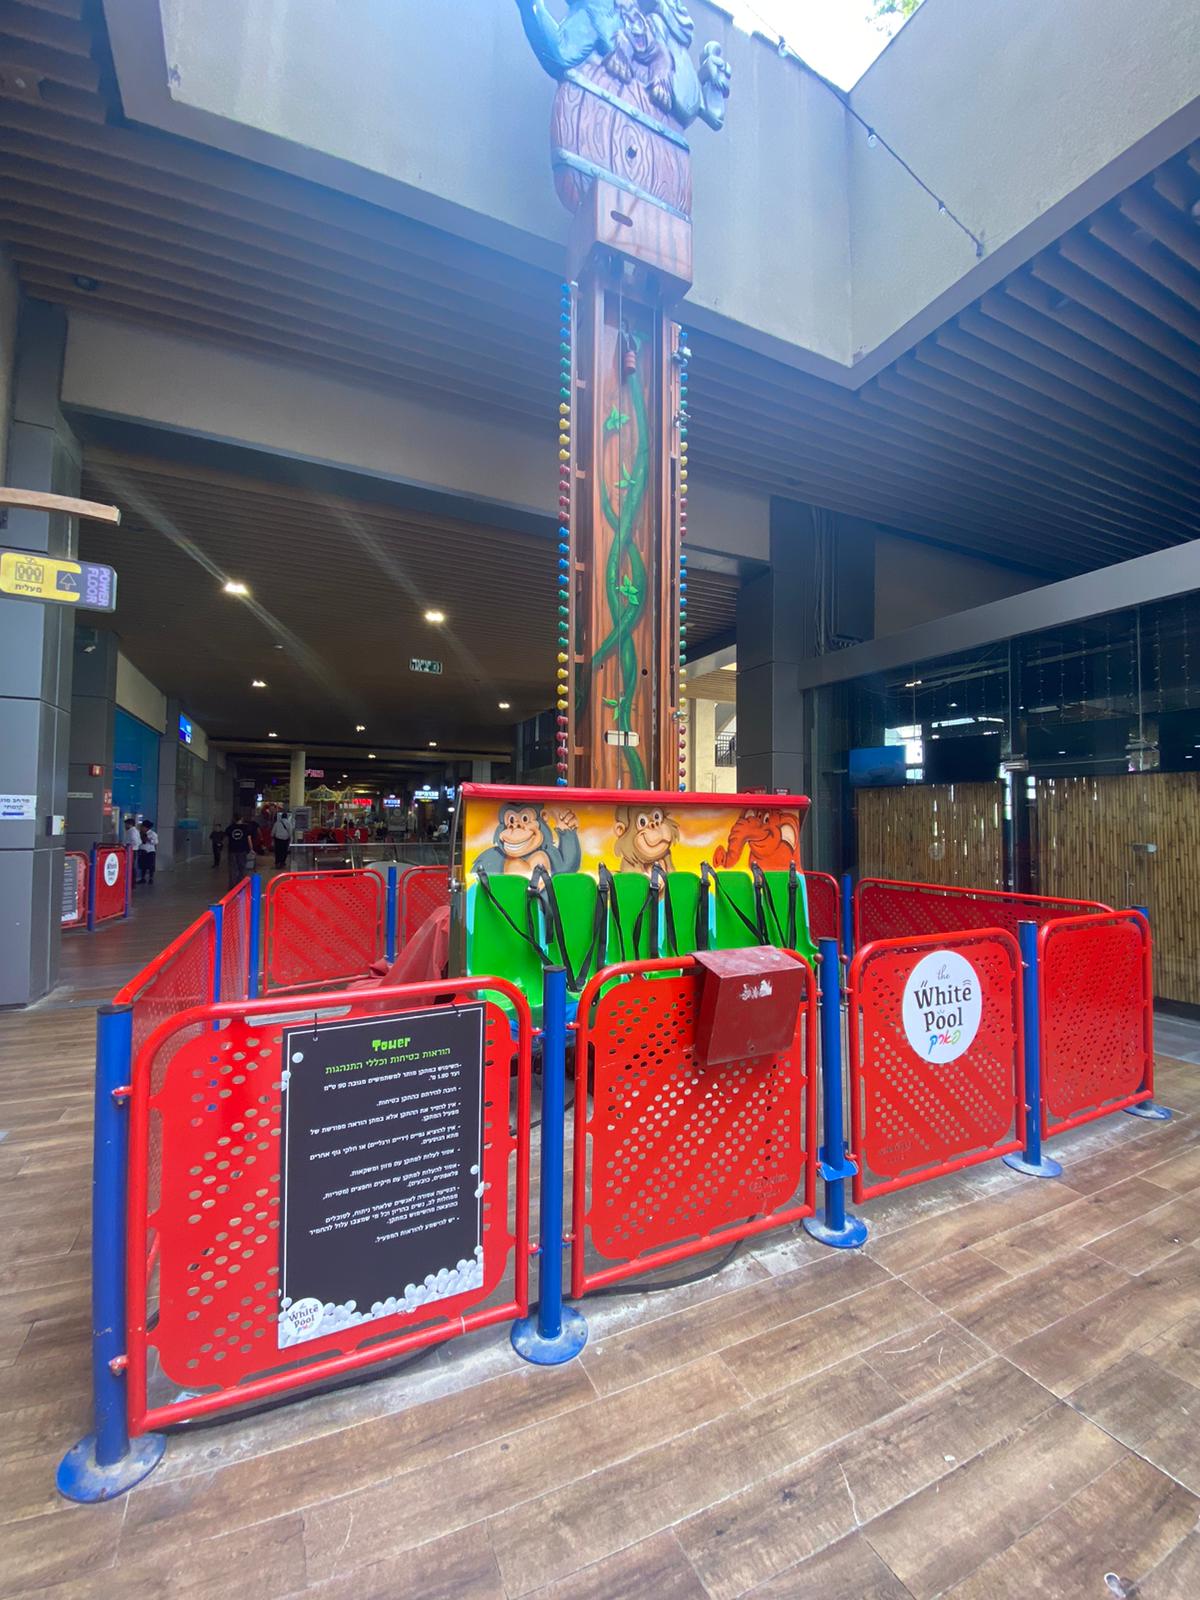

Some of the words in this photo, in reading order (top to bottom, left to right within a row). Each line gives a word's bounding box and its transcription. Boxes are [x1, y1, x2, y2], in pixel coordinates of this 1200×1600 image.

[15, 584, 42, 593] מעלית
[86, 567, 99, 603] FLOOR
[98, 567, 110, 607] POWER
[937, 963, 951, 980] the
[914, 983, 972, 1010] White
[923, 1007, 964, 1033] Pool
[928, 1030, 962, 1056] פארק
[390, 1053, 419, 1063] בטיחות
[423, 1048, 451, 1058] הוראות
[325, 1062, 362, 1074] התנהגות
[366, 1058, 387, 1066] וכללי
[288, 1306, 319, 1322] White
[294, 1314, 315, 1328] Pool
